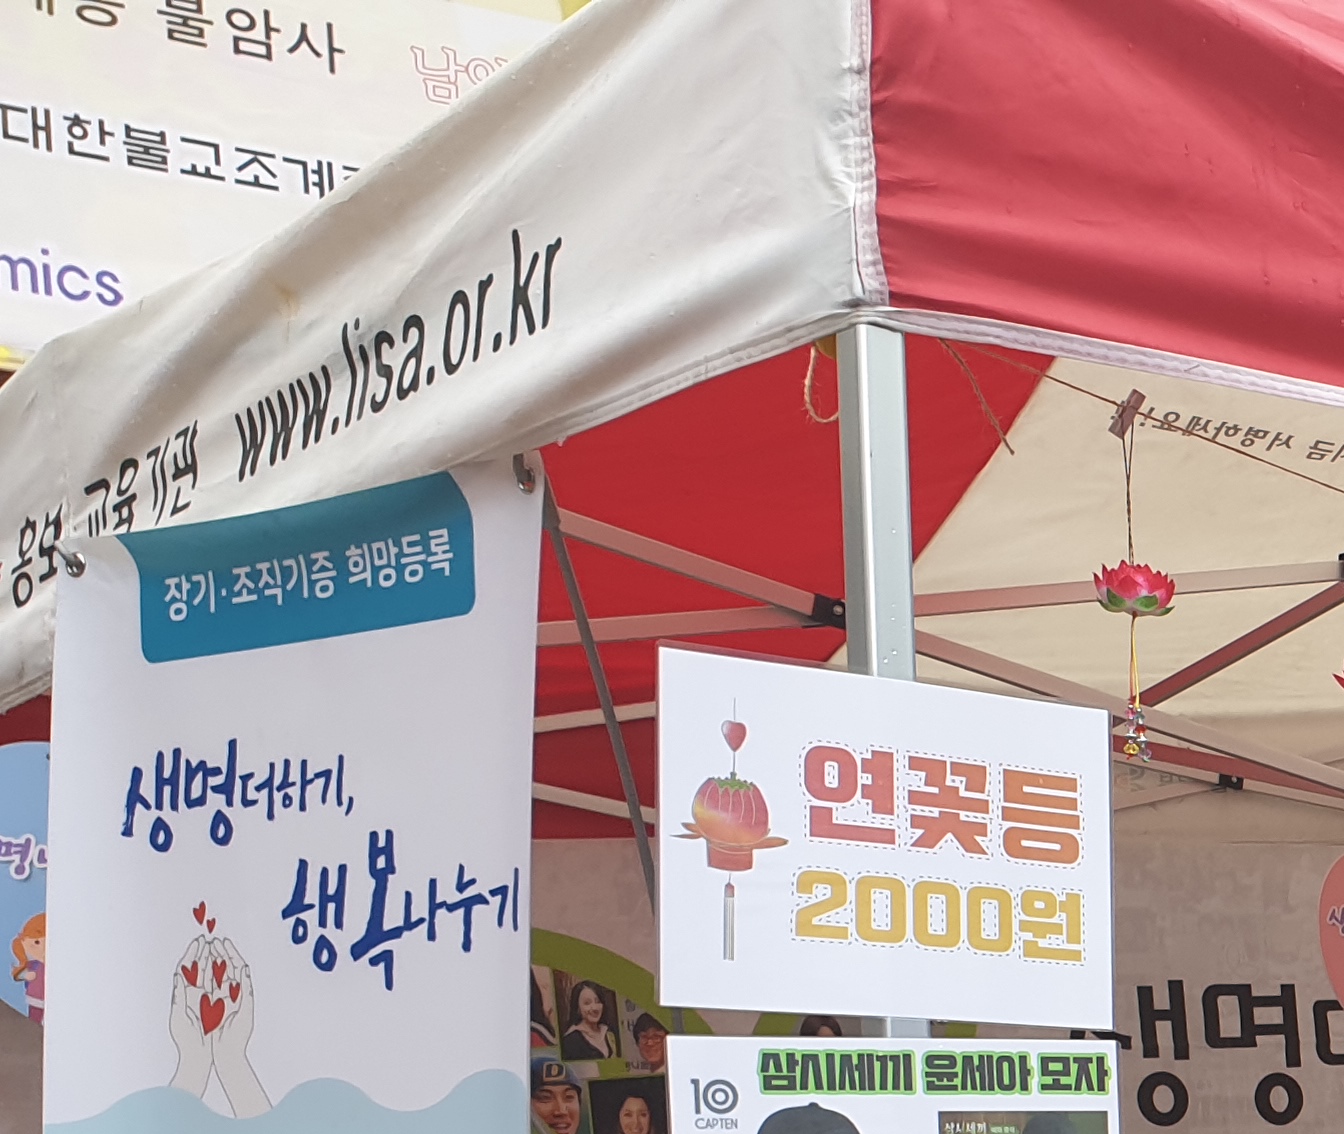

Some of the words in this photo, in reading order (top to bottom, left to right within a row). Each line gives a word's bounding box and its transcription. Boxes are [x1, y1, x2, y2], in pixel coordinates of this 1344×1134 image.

[0, 104, 361, 201] 대한불교조계
[235, 228, 562, 483] www.lisa.or.kr
[344, 528, 454, 588] 희망등록
[121, 738, 354, 852] 생명더하기,
[803, 745, 1081, 866] 연꽃등
[282, 829, 519, 990] 행복나누기
[794, 870, 1084, 963] 2000원
[760, 1051, 914, 1094] 삼시세끼
[924, 1053, 1032, 1094] 윤세아
[1039, 1055, 1110, 1095] 모자
[695, 1117, 739, 1131] CAPTEN
